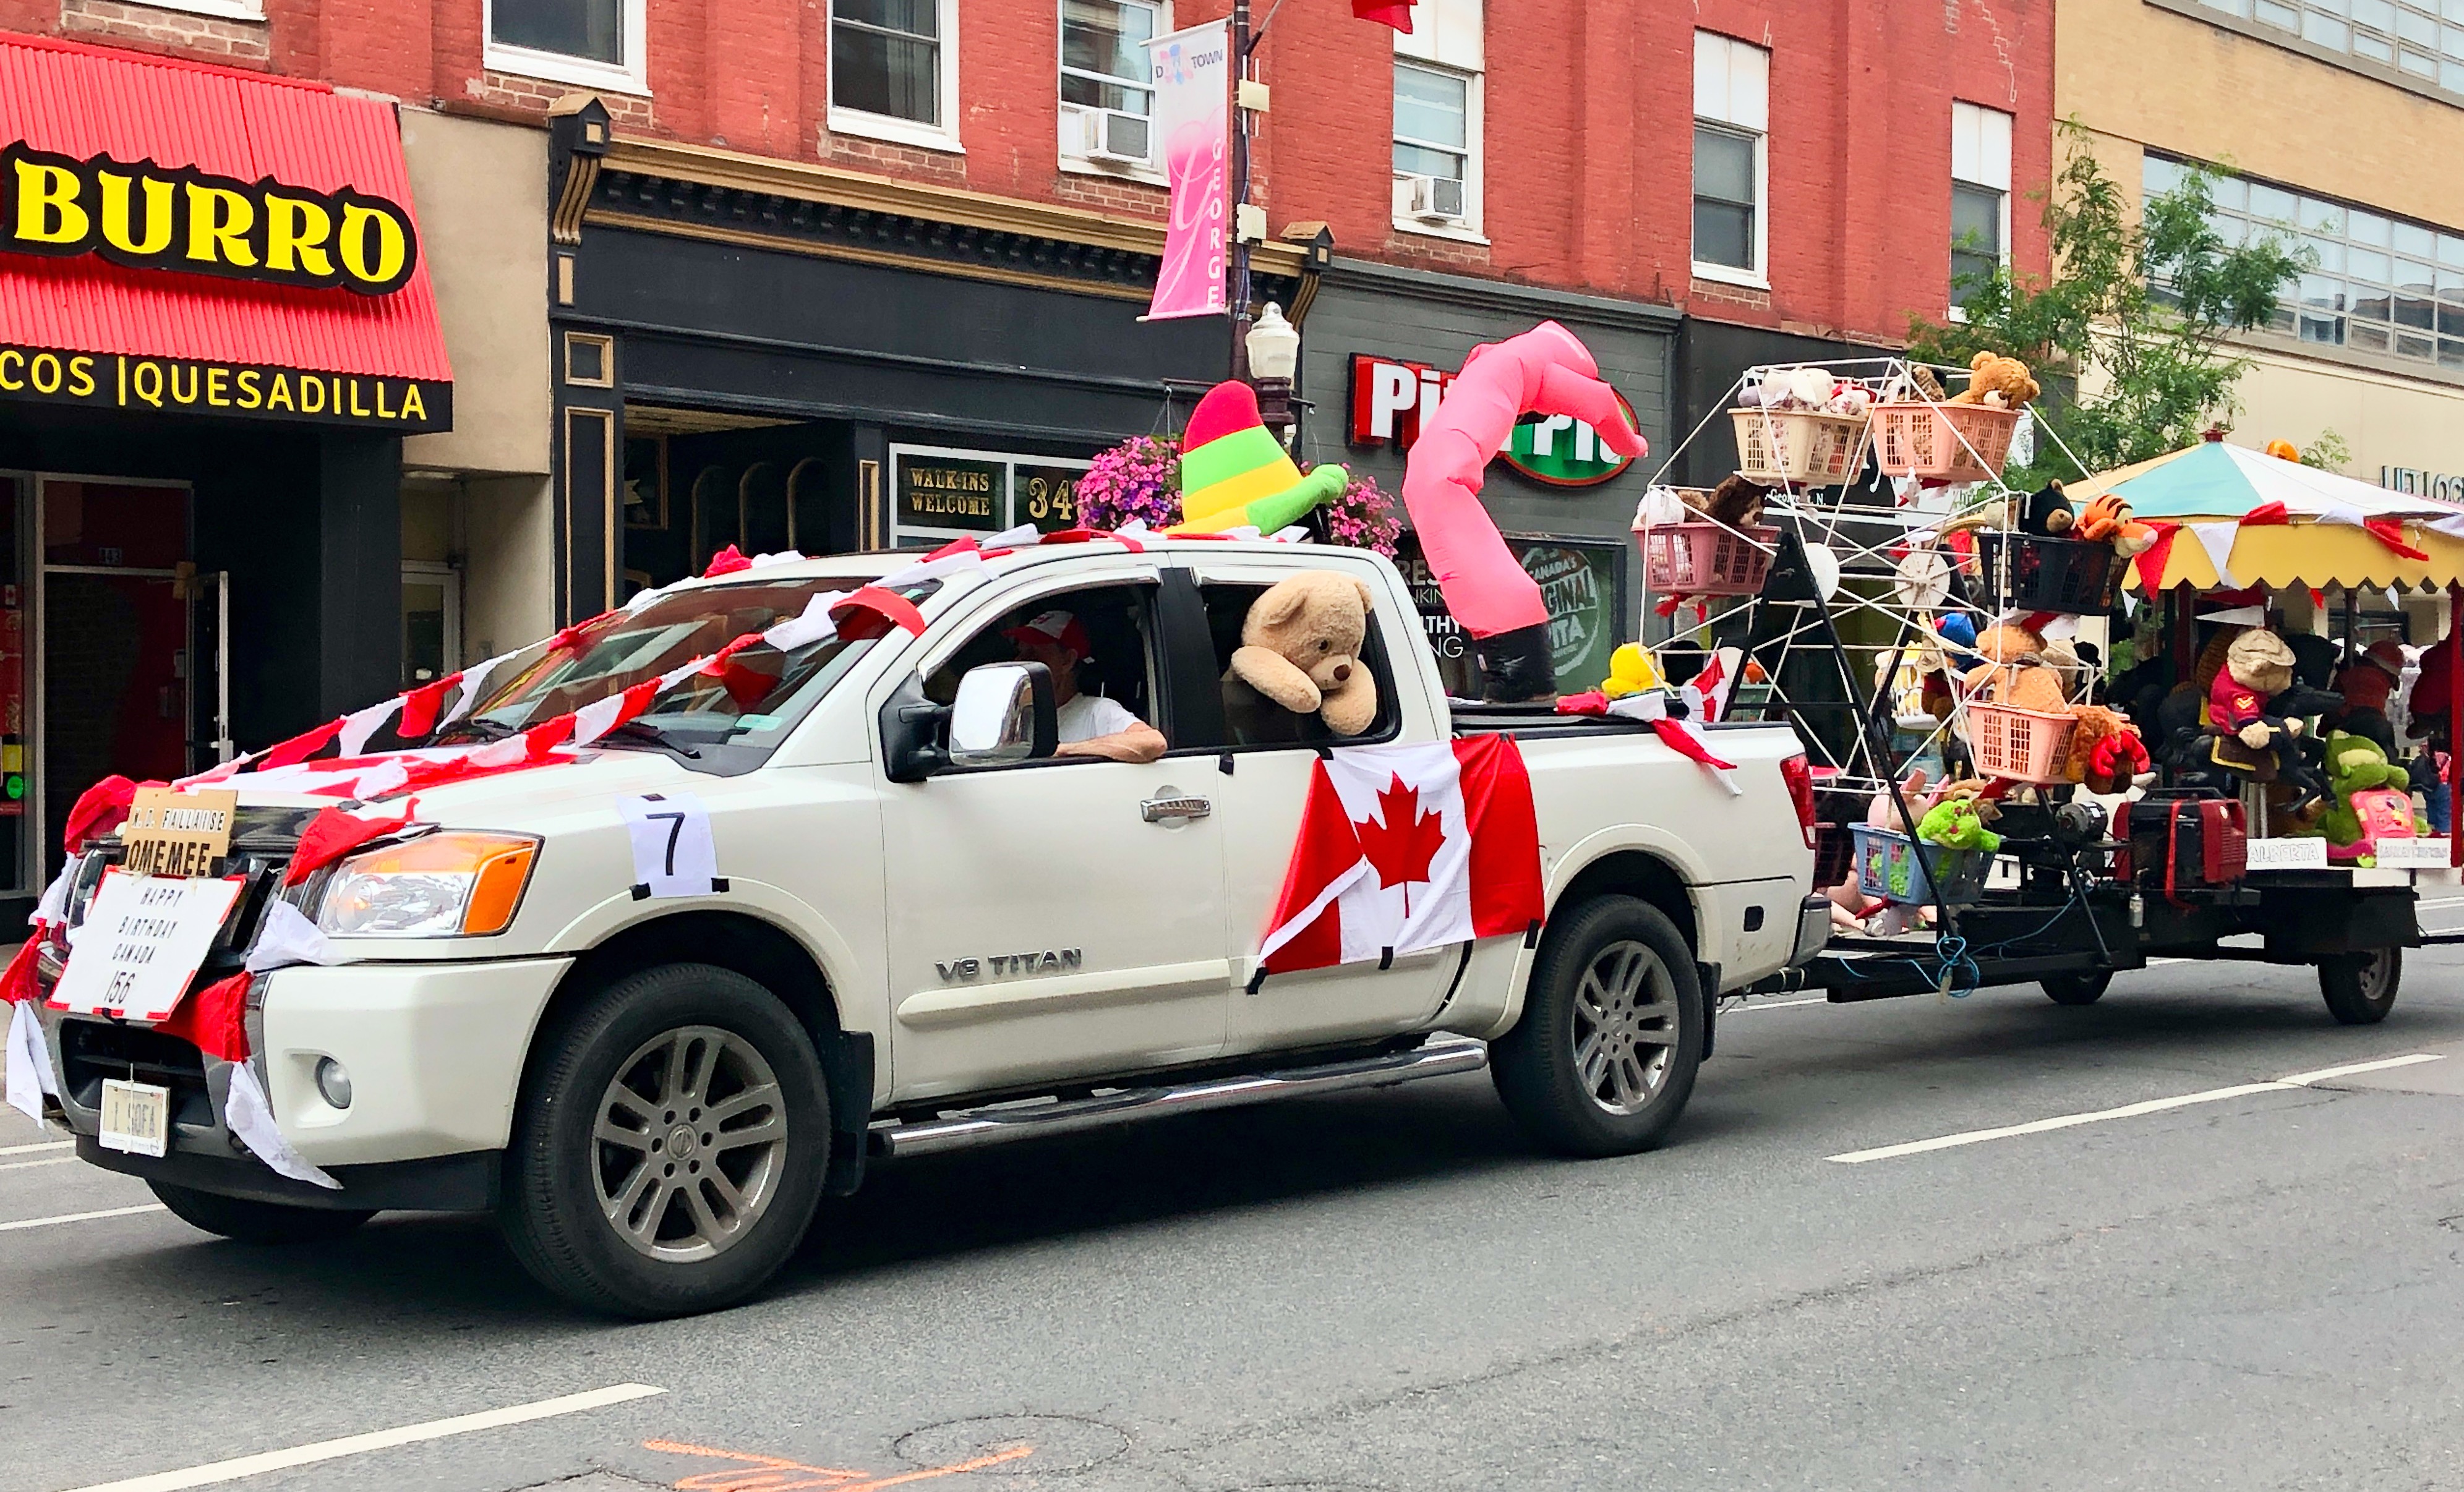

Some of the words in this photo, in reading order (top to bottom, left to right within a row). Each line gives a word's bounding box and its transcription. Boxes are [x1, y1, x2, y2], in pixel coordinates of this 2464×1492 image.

[14, 157, 406, 283] BURRO
[1207, 137, 1223, 309] GEORGE
[0, 350, 95, 396] COS
[133, 361, 428, 421] QUESADILLA
[910, 467, 990, 492] WALK-INS
[1769, 488, 1800, 504] Geoe
[2423, 471, 2464, 504] LOC
[910, 492, 990, 516] WELCOME
[1029, 477, 1082, 521] 34
[1420, 615, 1460, 634] THY
[1547, 614, 1586, 649] ITA
[128, 839, 211, 877] OMEMEE
[644, 811, 686, 876] 7
[2248, 842, 2319, 863] ALBERTA
[139, 887, 184, 908] HAPPY
[118, 915, 178, 939] BIRTHDAY
[112, 942, 156, 964] CANADA
[934, 956, 980, 980] V8
[988, 947, 1082, 976] TITAN
[103, 970, 136, 1005] 156
